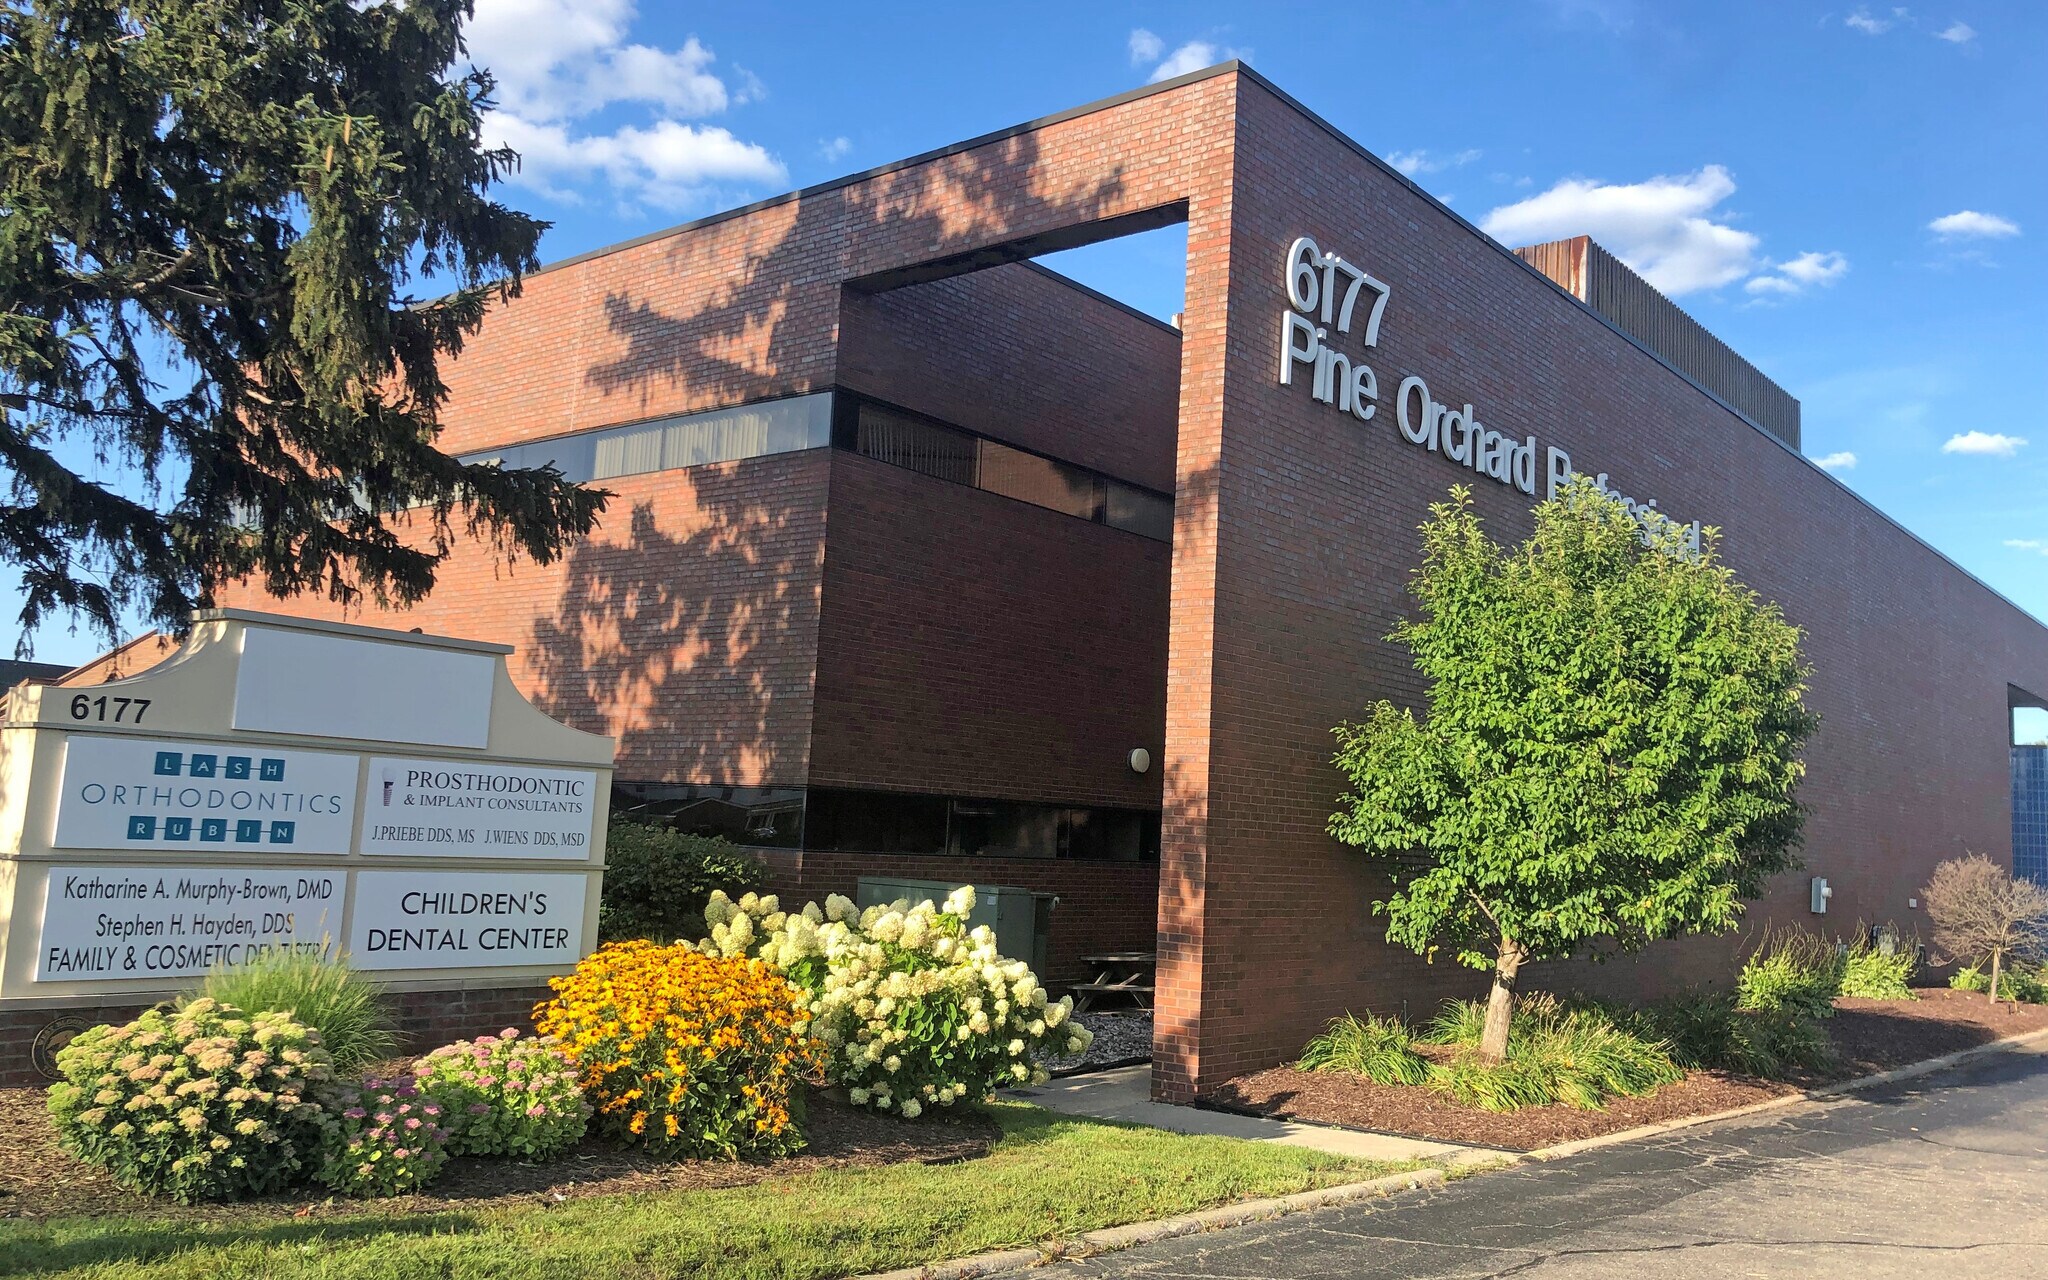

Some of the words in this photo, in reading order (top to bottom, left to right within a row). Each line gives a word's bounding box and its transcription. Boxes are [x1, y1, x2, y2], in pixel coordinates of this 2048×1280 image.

[1286, 237, 1391, 347] 6177
[1280, 310, 1378, 421] Pine
[1396, 376, 1536, 496] Orchard
[70, 694, 152, 724] 6177
[163, 758, 279, 777] LASH
[406, 770, 585, 797] PROSTHODONTIC
[81, 783, 342, 814] ORTHODONTICS
[403, 794, 416, 806] &
[420, 794, 485, 809] IMPLANT
[488, 797, 583, 814] CONSULTANTS
[135, 821, 289, 840] RUBIN
[427, 828, 455, 845] DDS,
[457, 829, 476, 843] MS
[534, 831, 559, 848] DDS,
[560, 832, 585, 847] MSD
[64, 875, 148, 899] Katharine
[153, 876, 170, 899] A.
[175, 877, 292, 906] Murphy-Brown,
[296, 879, 333, 900] DMD
[401, 891, 548, 915] CHILDREN'S
[96, 913, 164, 942] Stephen
[169, 913, 186, 936] H.
[192, 913, 257, 940] Hayden,
[262, 912, 295, 934] DDS
[367, 928, 469, 951] DENTAL
[478, 928, 569, 950] CENTER
[47, 947, 119, 973] FAMILY
[123, 945, 137, 971] &
[145, 943, 241, 971] COSMETIC
